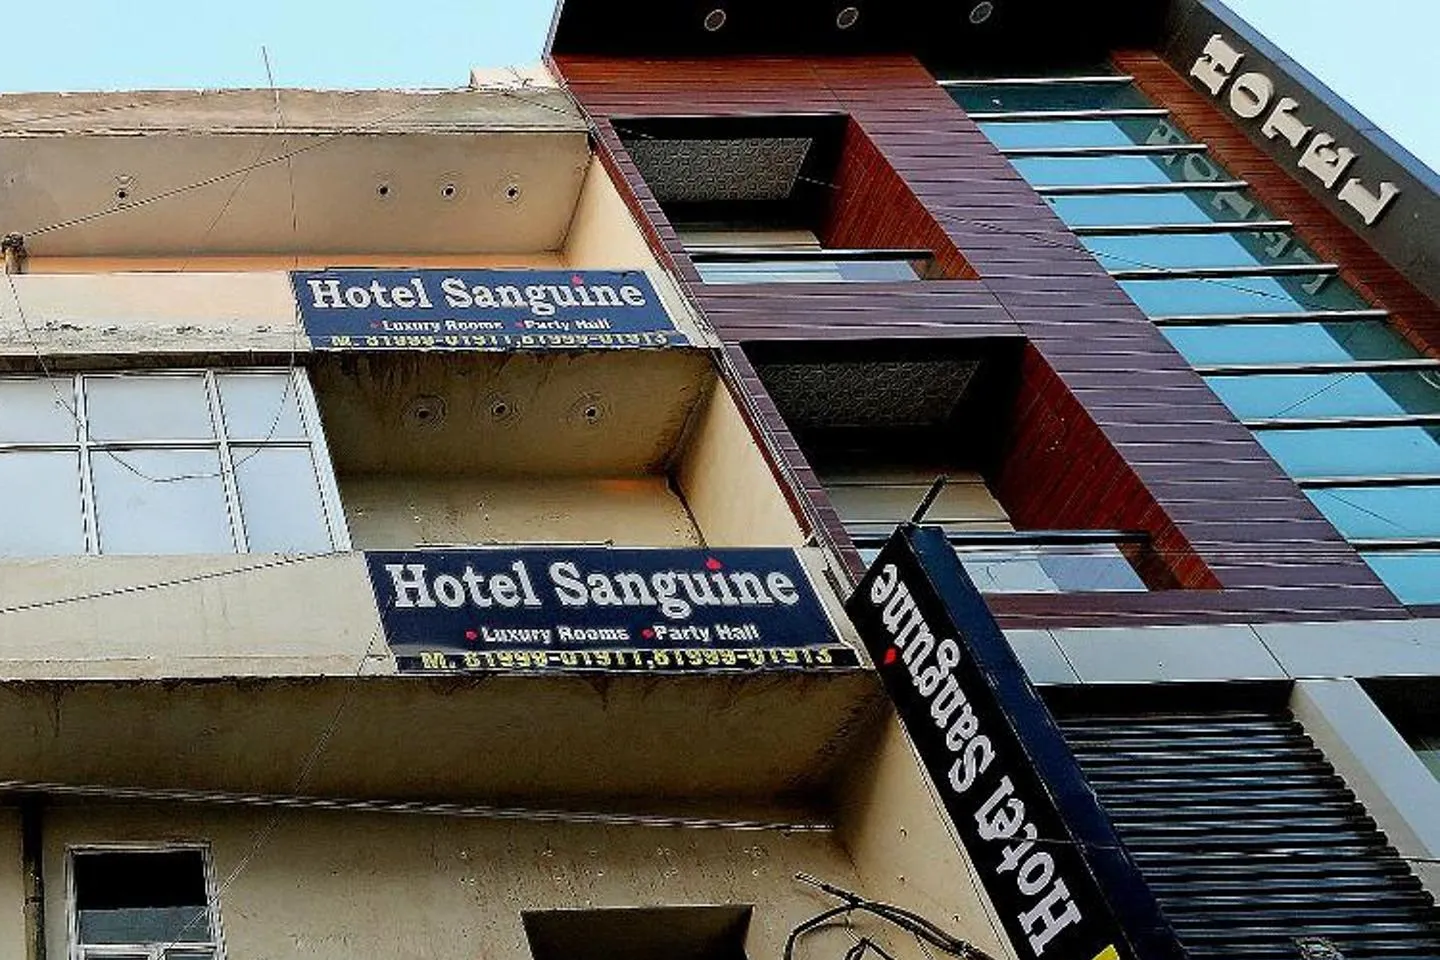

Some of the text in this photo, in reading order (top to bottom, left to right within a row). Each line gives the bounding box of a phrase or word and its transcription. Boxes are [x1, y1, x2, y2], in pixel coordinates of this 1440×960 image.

[1189, 33, 1400, 226] HOTEL
[307, 274, 646, 316] Hotel Sanguine
[382, 319, 611, 333] Luxury Rooms Party Hall
[385, 558, 799, 619] Hotel Sanguine
[481, 623, 762, 644] Luxury Rooms Party Hall
[421, 652, 457, 669] M.
[870, 563, 1083, 958] Hotel Sanguine
